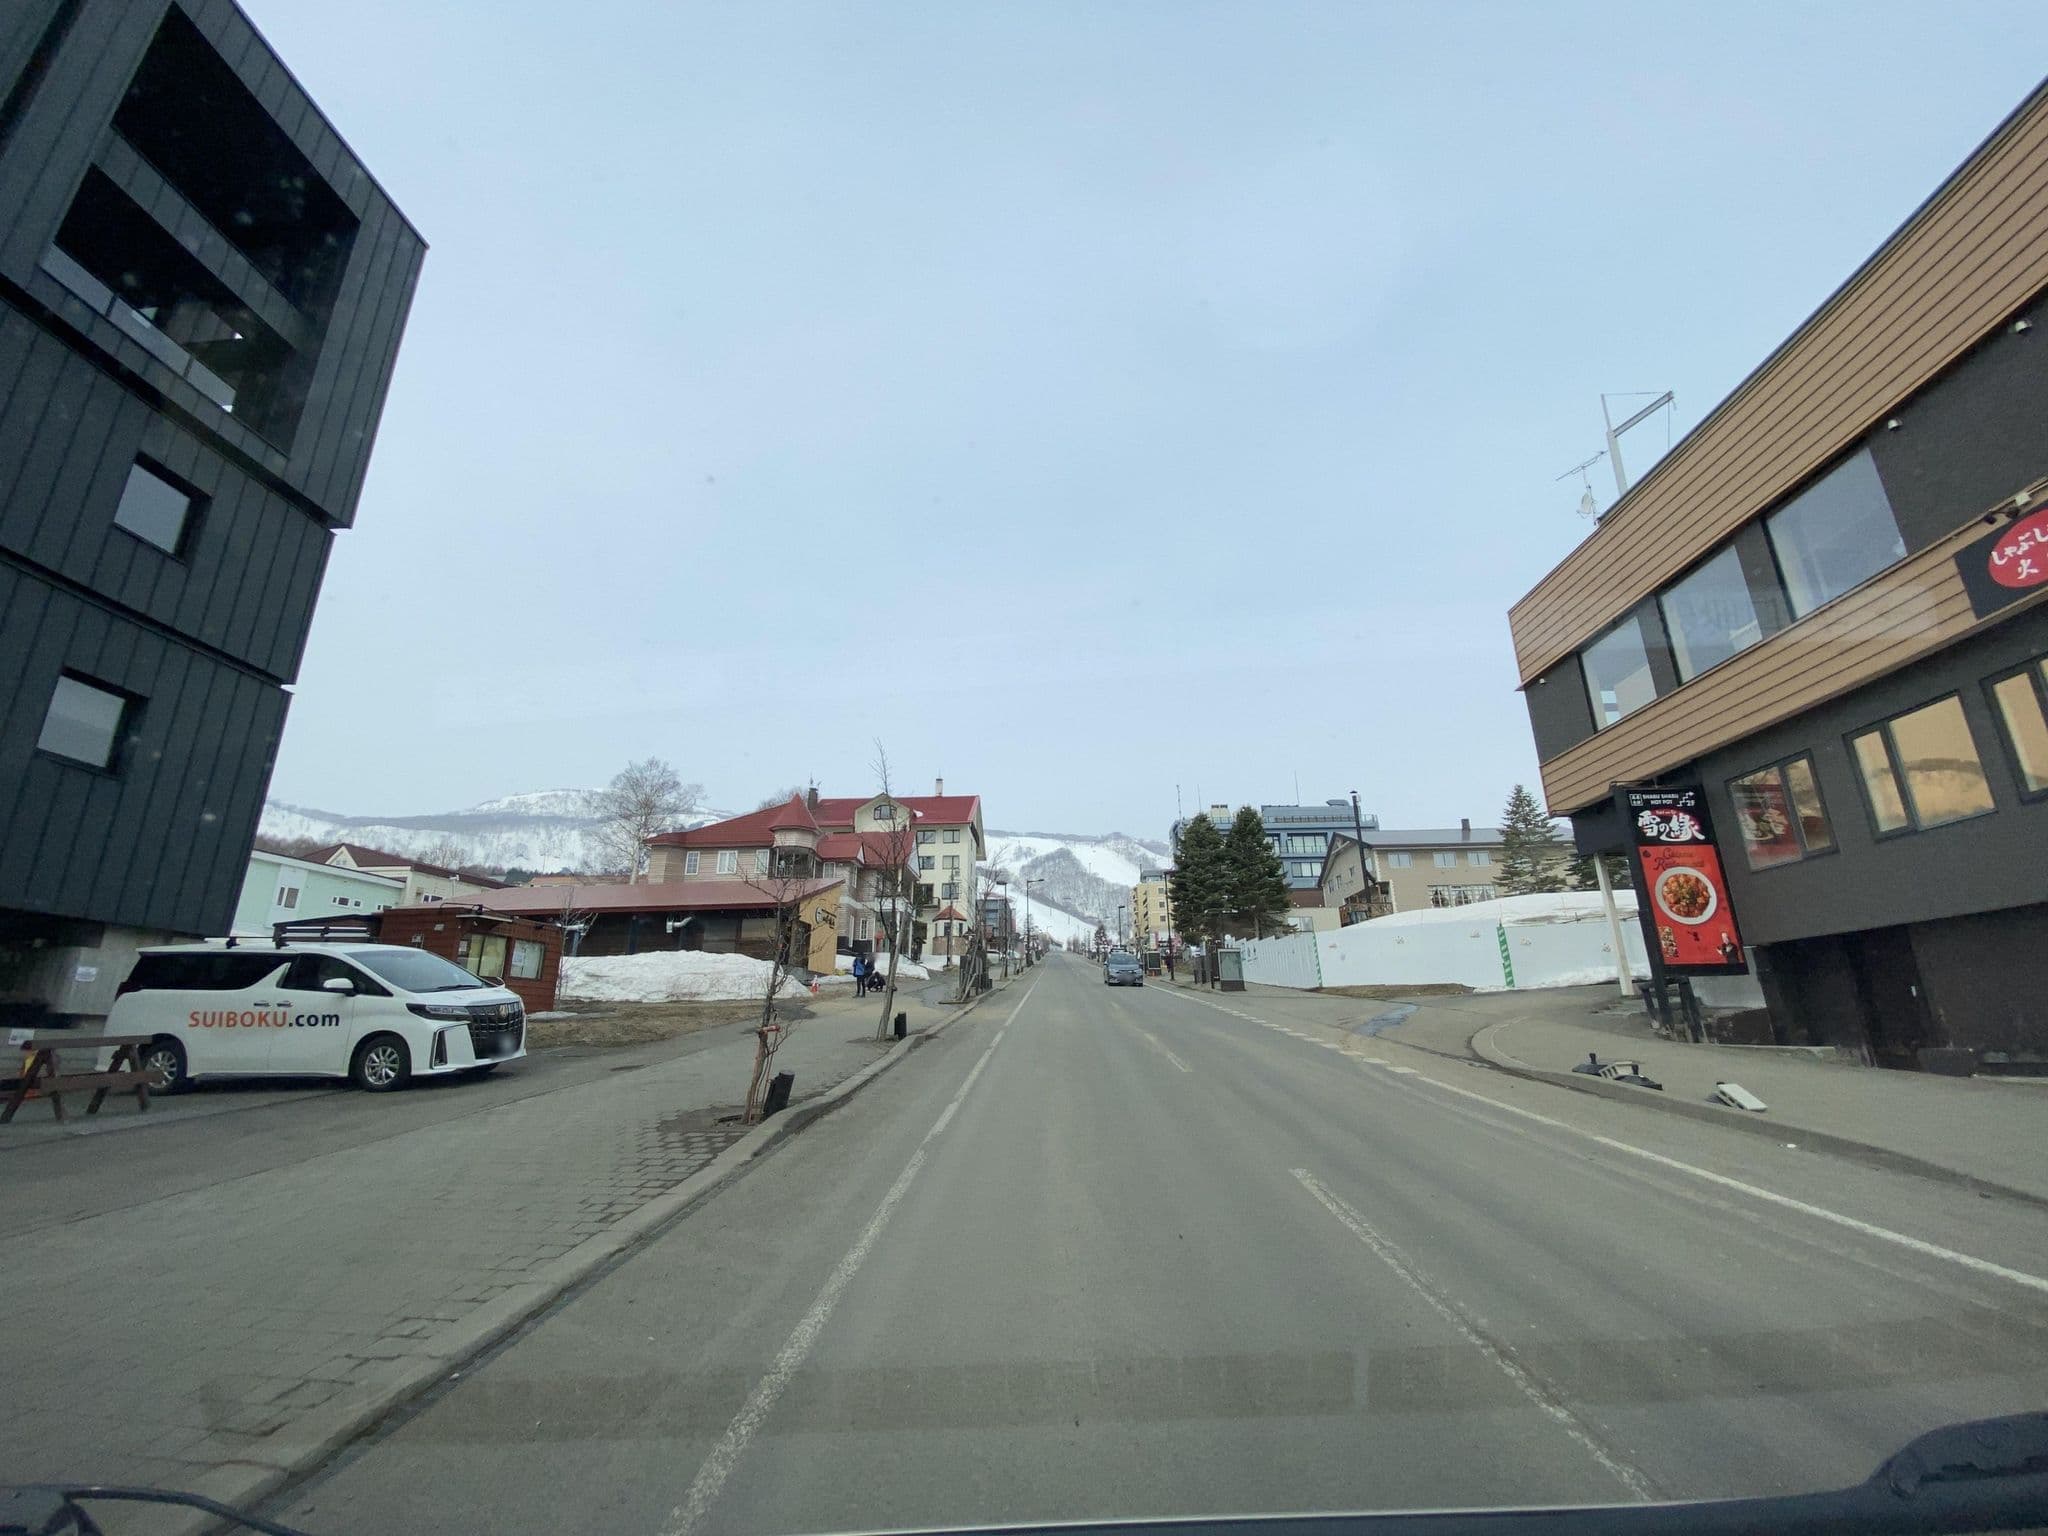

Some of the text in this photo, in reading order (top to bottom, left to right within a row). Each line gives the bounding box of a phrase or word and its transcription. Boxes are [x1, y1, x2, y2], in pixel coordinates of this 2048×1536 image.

[1991, 526, 2048, 564] しゃぶし
[2017, 557, 2048, 579] 火
[188, 1011, 340, 1028] SUIBOKU.com
